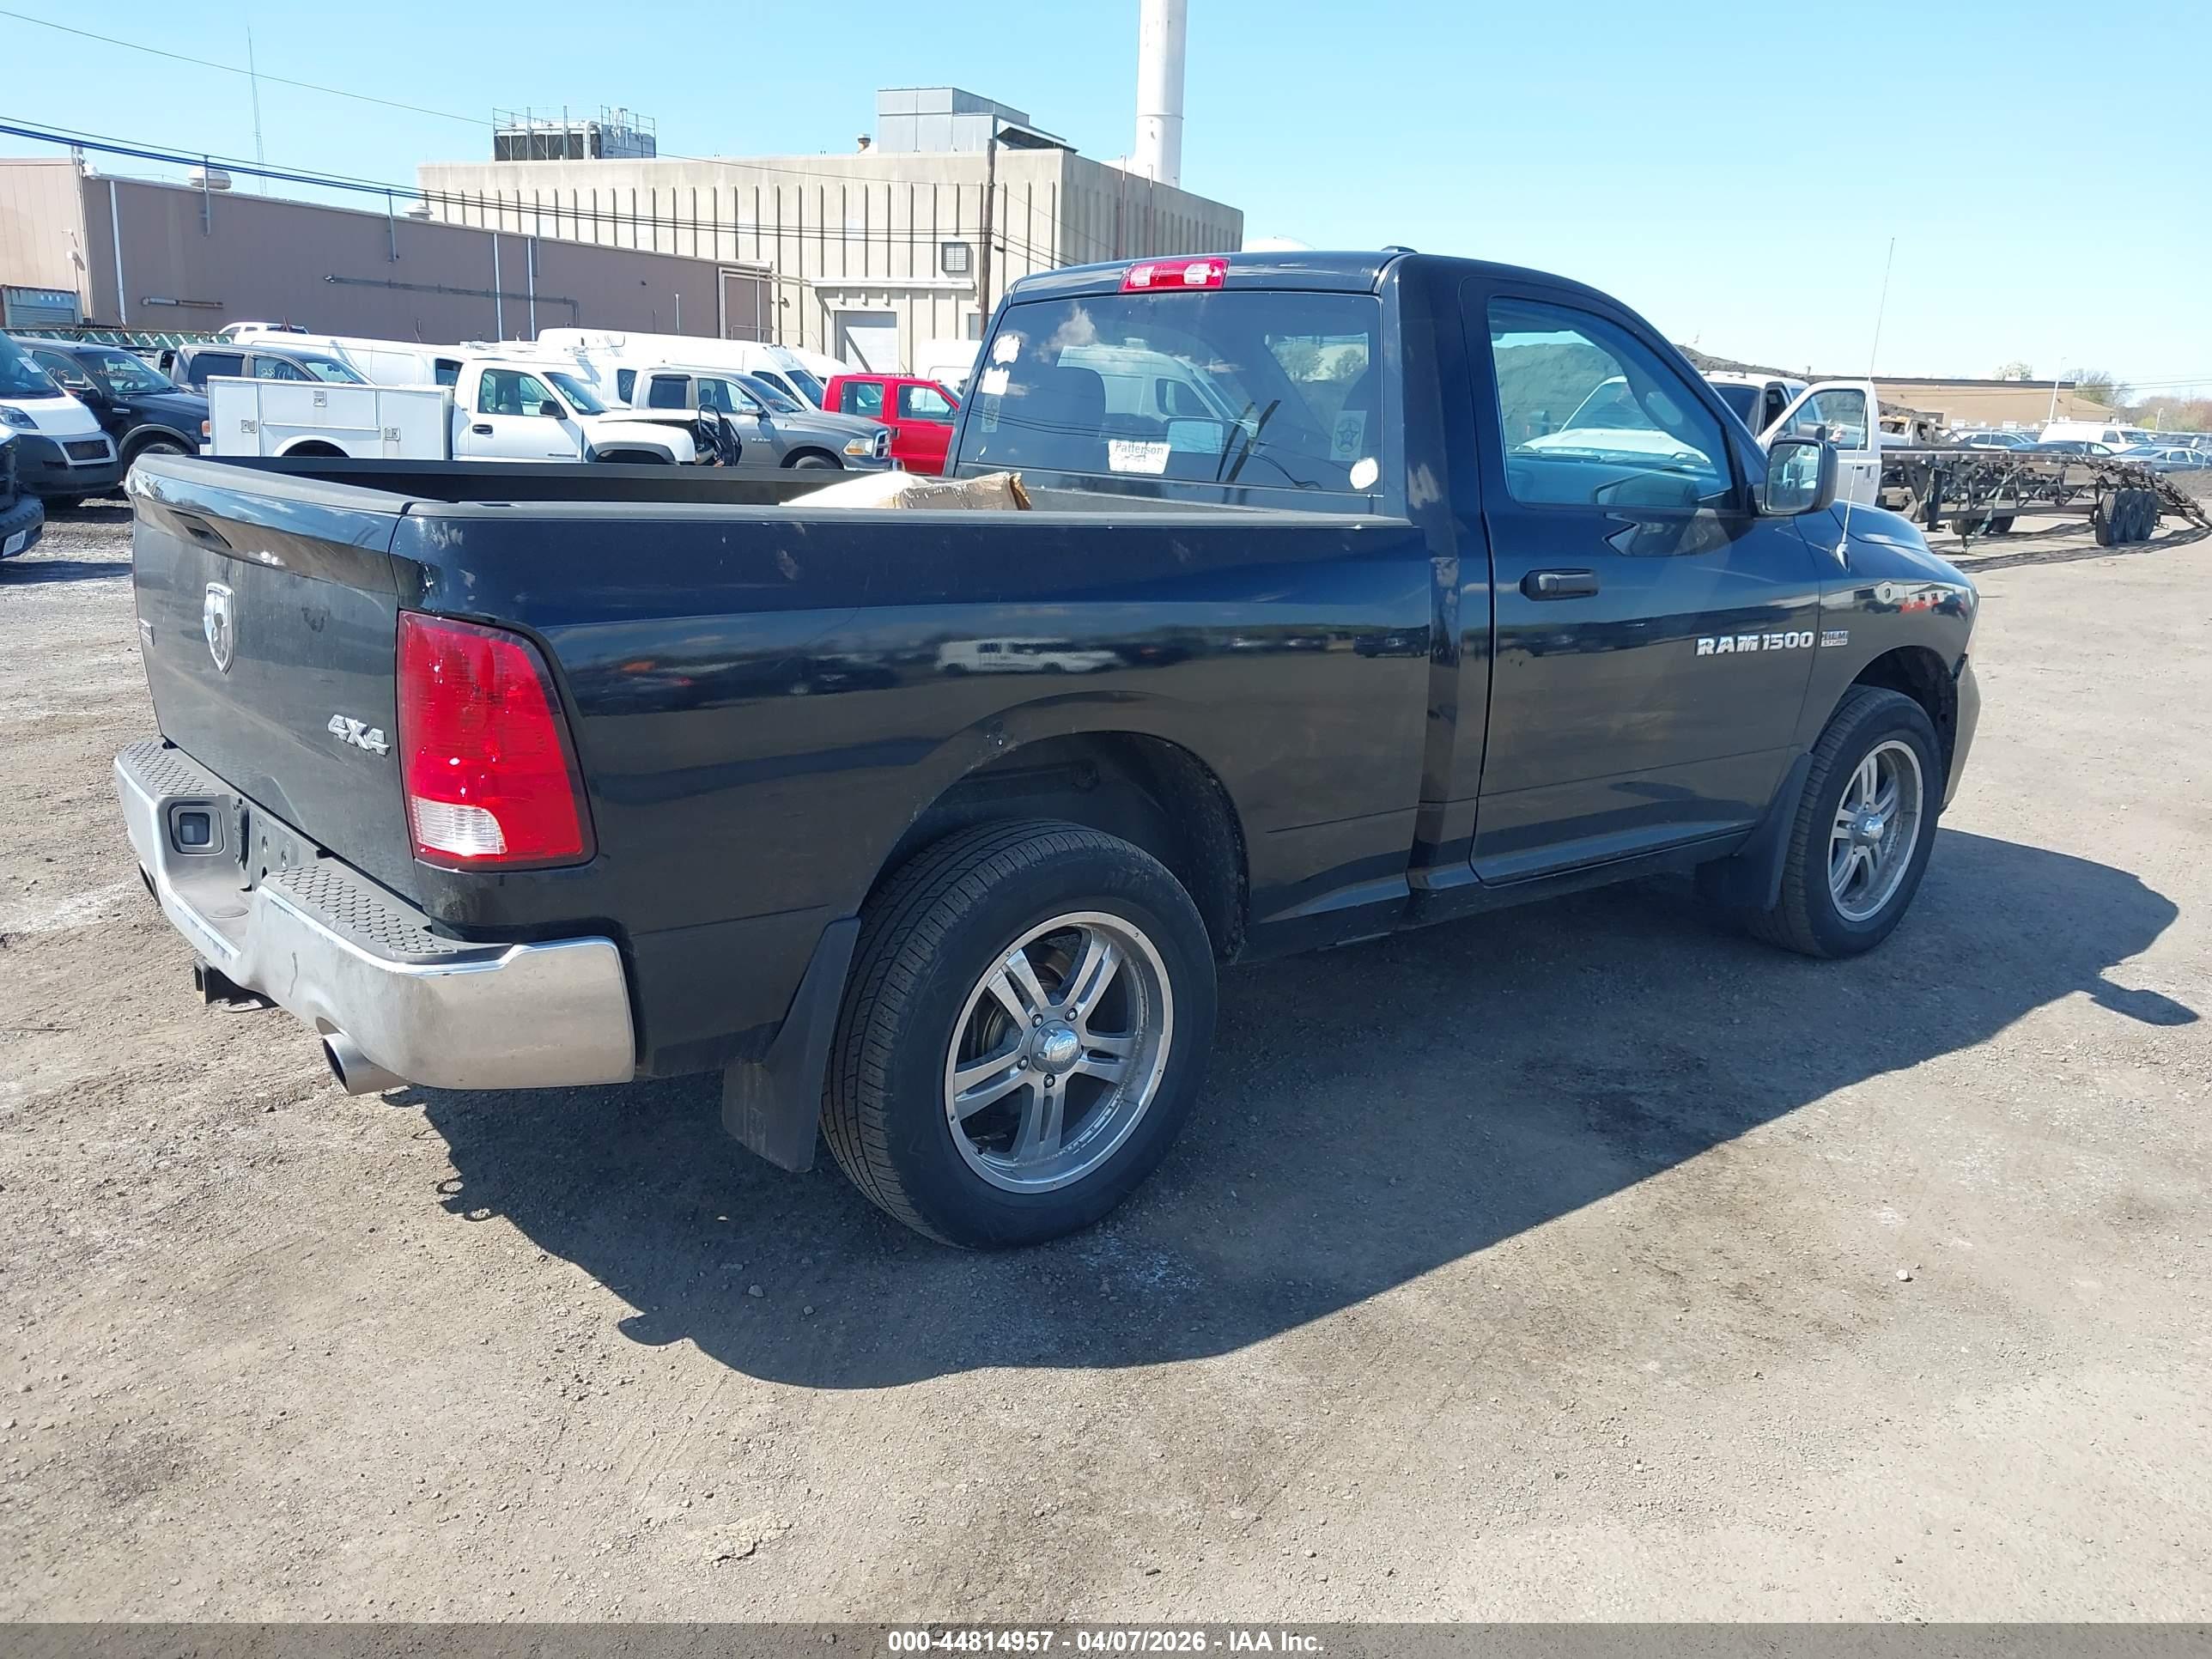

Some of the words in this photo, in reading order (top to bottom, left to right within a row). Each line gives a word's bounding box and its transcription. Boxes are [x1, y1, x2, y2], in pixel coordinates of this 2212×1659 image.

[1115, 441, 1164, 455] Patterson
[1696, 635, 1759, 656] RAM
[1762, 631, 1814, 651] 1500
